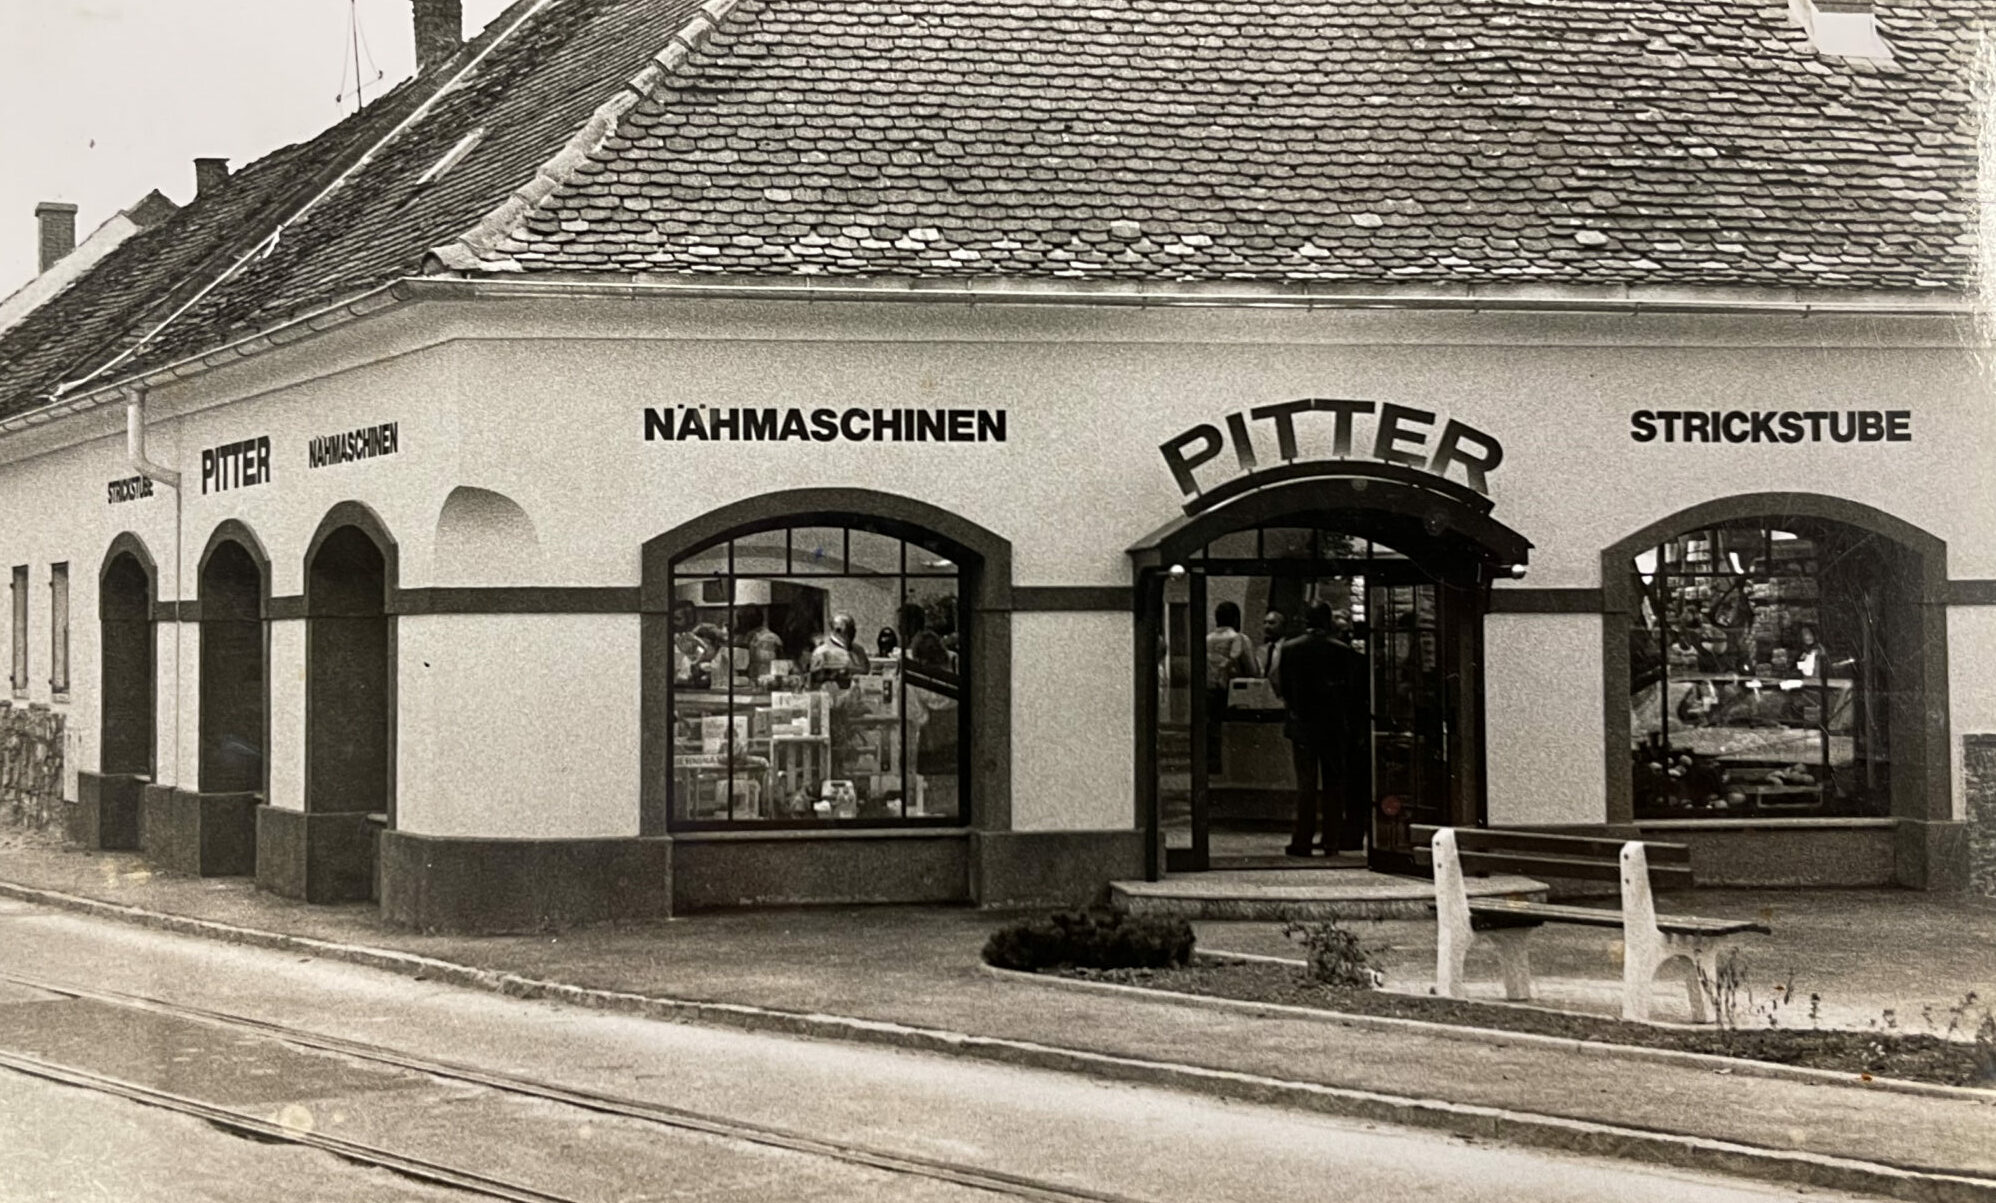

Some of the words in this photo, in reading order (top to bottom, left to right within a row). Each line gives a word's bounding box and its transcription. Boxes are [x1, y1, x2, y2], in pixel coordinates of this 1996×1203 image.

[308, 421, 398, 468] NÄHMASCHINEN
[644, 404, 1007, 442] NÄHMASCHINEN
[1630, 409, 1912, 444] STRICKSTUBE
[202, 435, 270, 495] PITTER
[1158, 398, 1504, 497] PITTER
